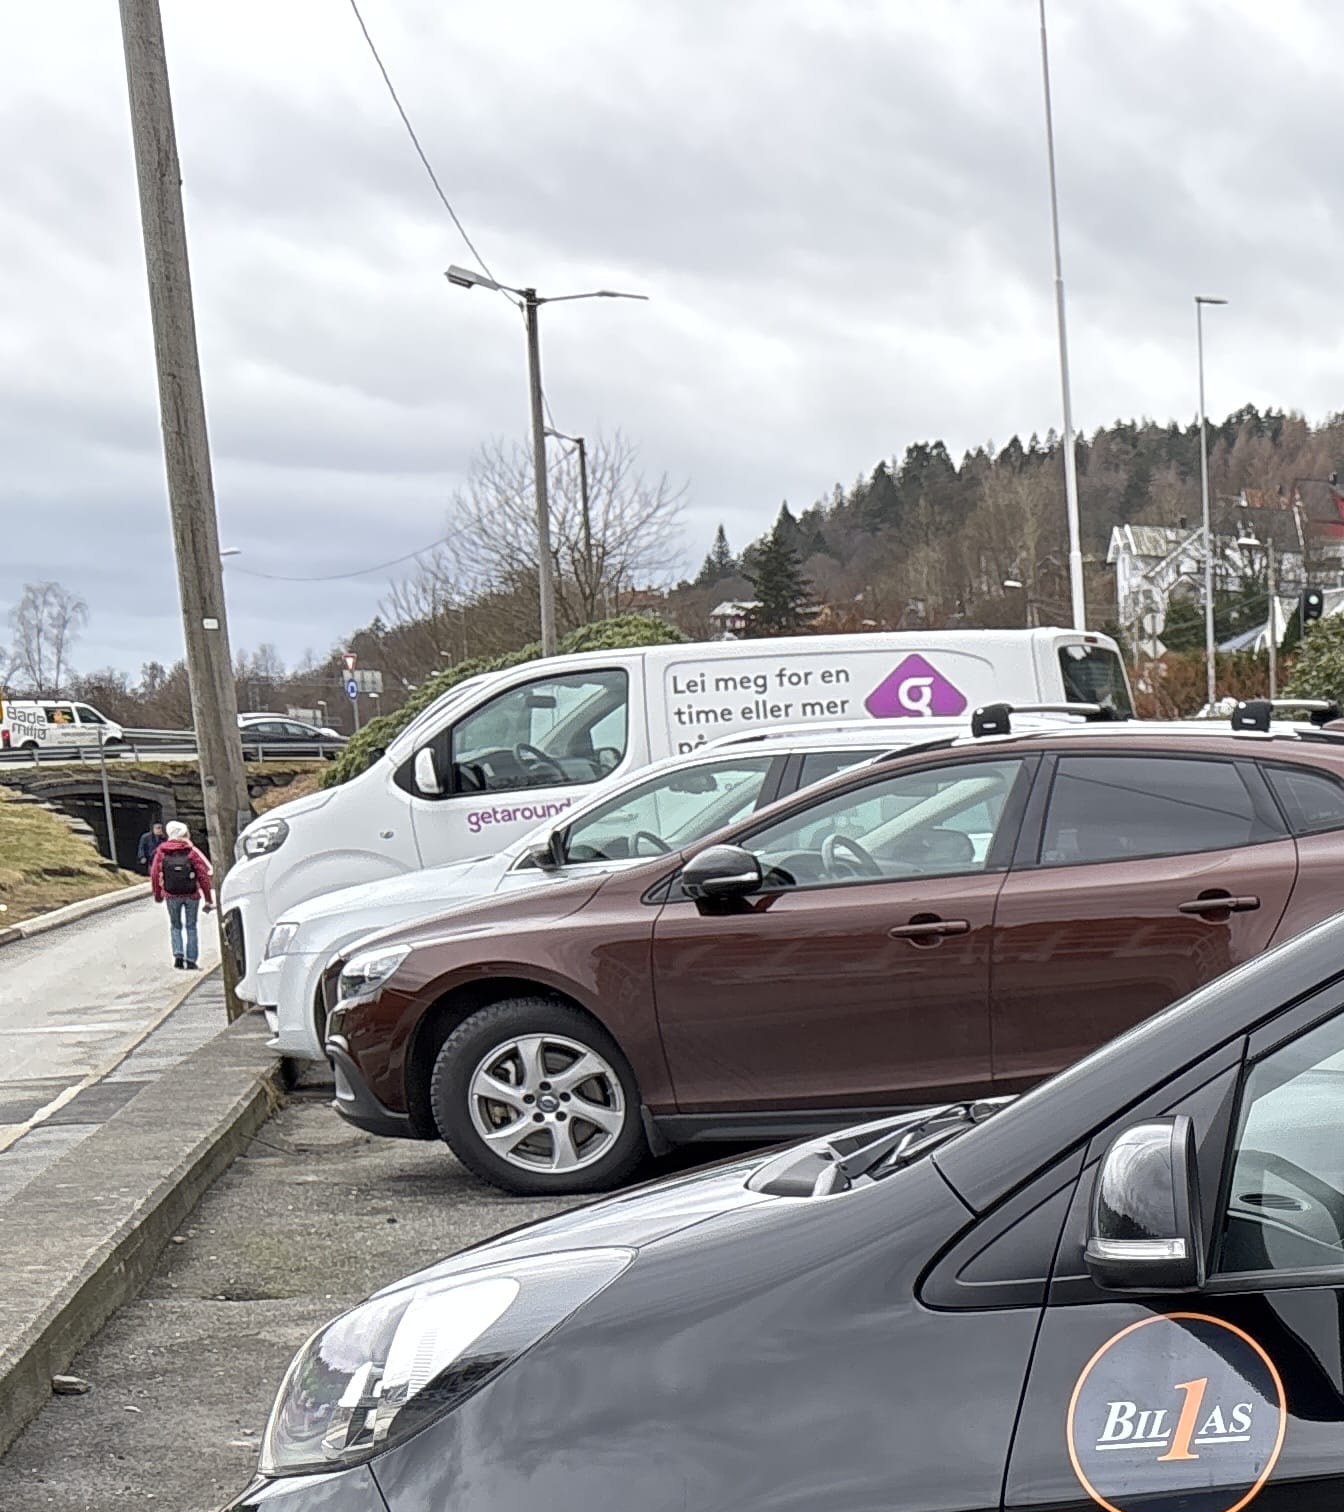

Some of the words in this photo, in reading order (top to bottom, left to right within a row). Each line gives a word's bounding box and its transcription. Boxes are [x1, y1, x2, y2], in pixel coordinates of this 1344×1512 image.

[672, 672, 706, 695] Lei
[715, 675, 768, 696] meg
[775, 667, 813, 688] for
[822, 668, 850, 685] en
[674, 705, 733, 726] time
[741, 700, 793, 721] eller
[802, 699, 850, 717] mer
